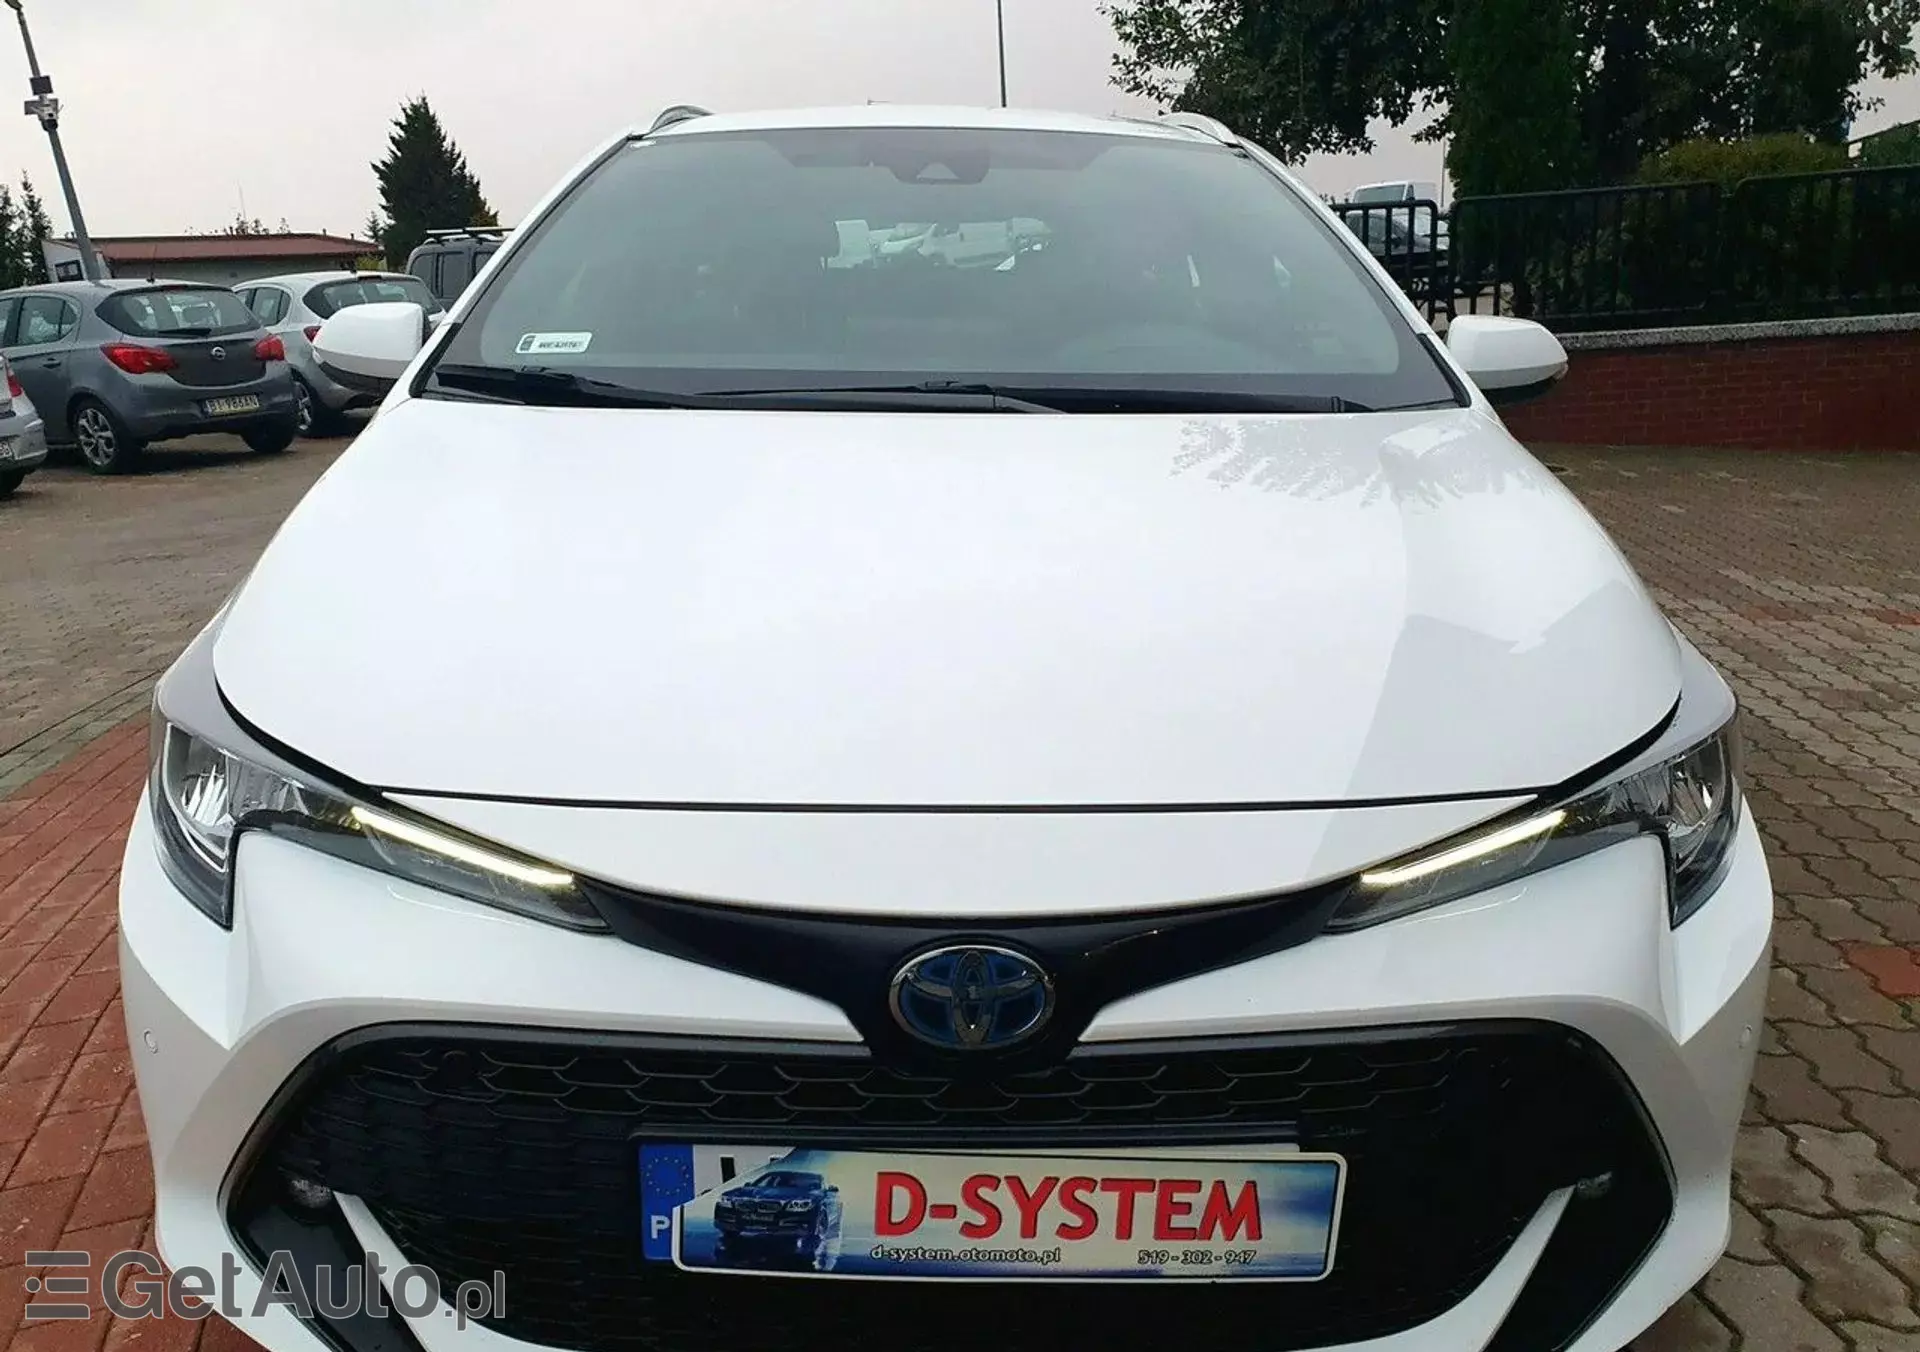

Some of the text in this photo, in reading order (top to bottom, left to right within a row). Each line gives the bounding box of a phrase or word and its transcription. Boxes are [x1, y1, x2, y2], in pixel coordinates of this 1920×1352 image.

[874, 1171, 1263, 1241] D-SYSTEM
[651, 1215, 671, 1239] P
[870, 1245, 1061, 1265] d-system.otomoto.pl
[1137, 1249, 1170, 1265] 519
[1181, 1249, 1213, 1265] 302
[1224, 1249, 1257, 1265] 947
